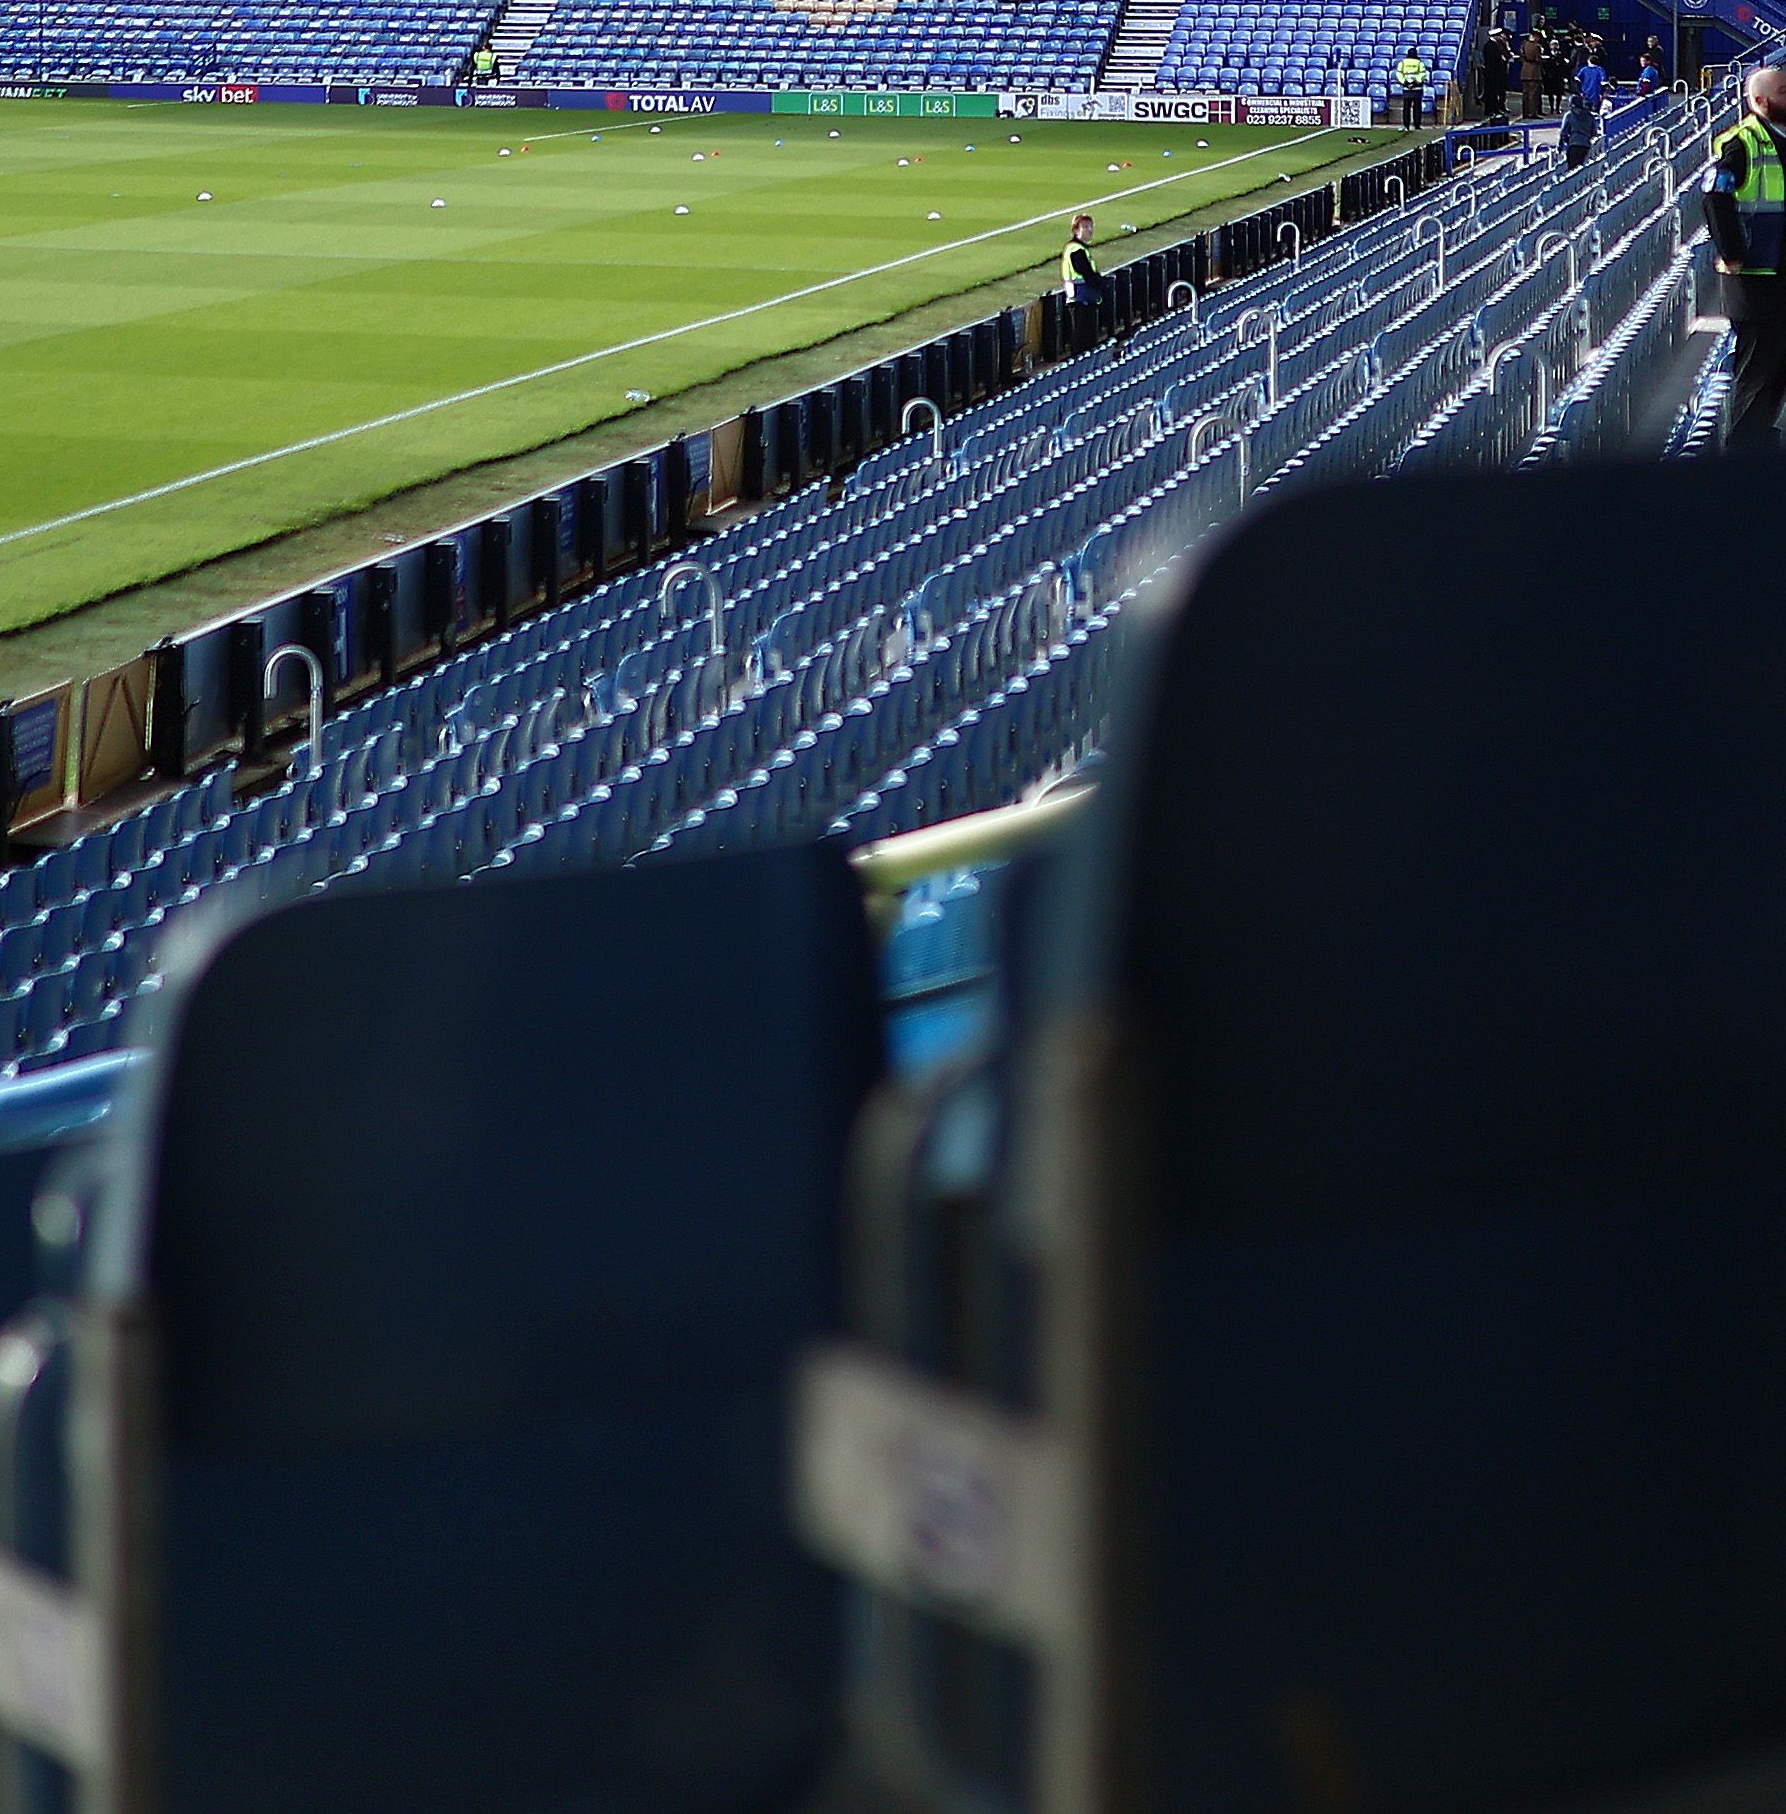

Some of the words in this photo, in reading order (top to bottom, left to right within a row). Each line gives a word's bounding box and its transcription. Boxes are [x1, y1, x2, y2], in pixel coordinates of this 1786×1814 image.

[182, 86, 216, 103] sky
[221, 86, 254, 103] bet
[1041, 95, 1060, 106] dbs
[813, 99, 838, 112] L&S
[869, 100, 894, 113] L&S
[925, 100, 950, 114] L&S
[1134, 102, 1208, 119] SWGC
[1247, 114, 1266, 125] 023
[1268, 114, 1294, 125] 9237
[1295, 115, 1322, 126] 8855
